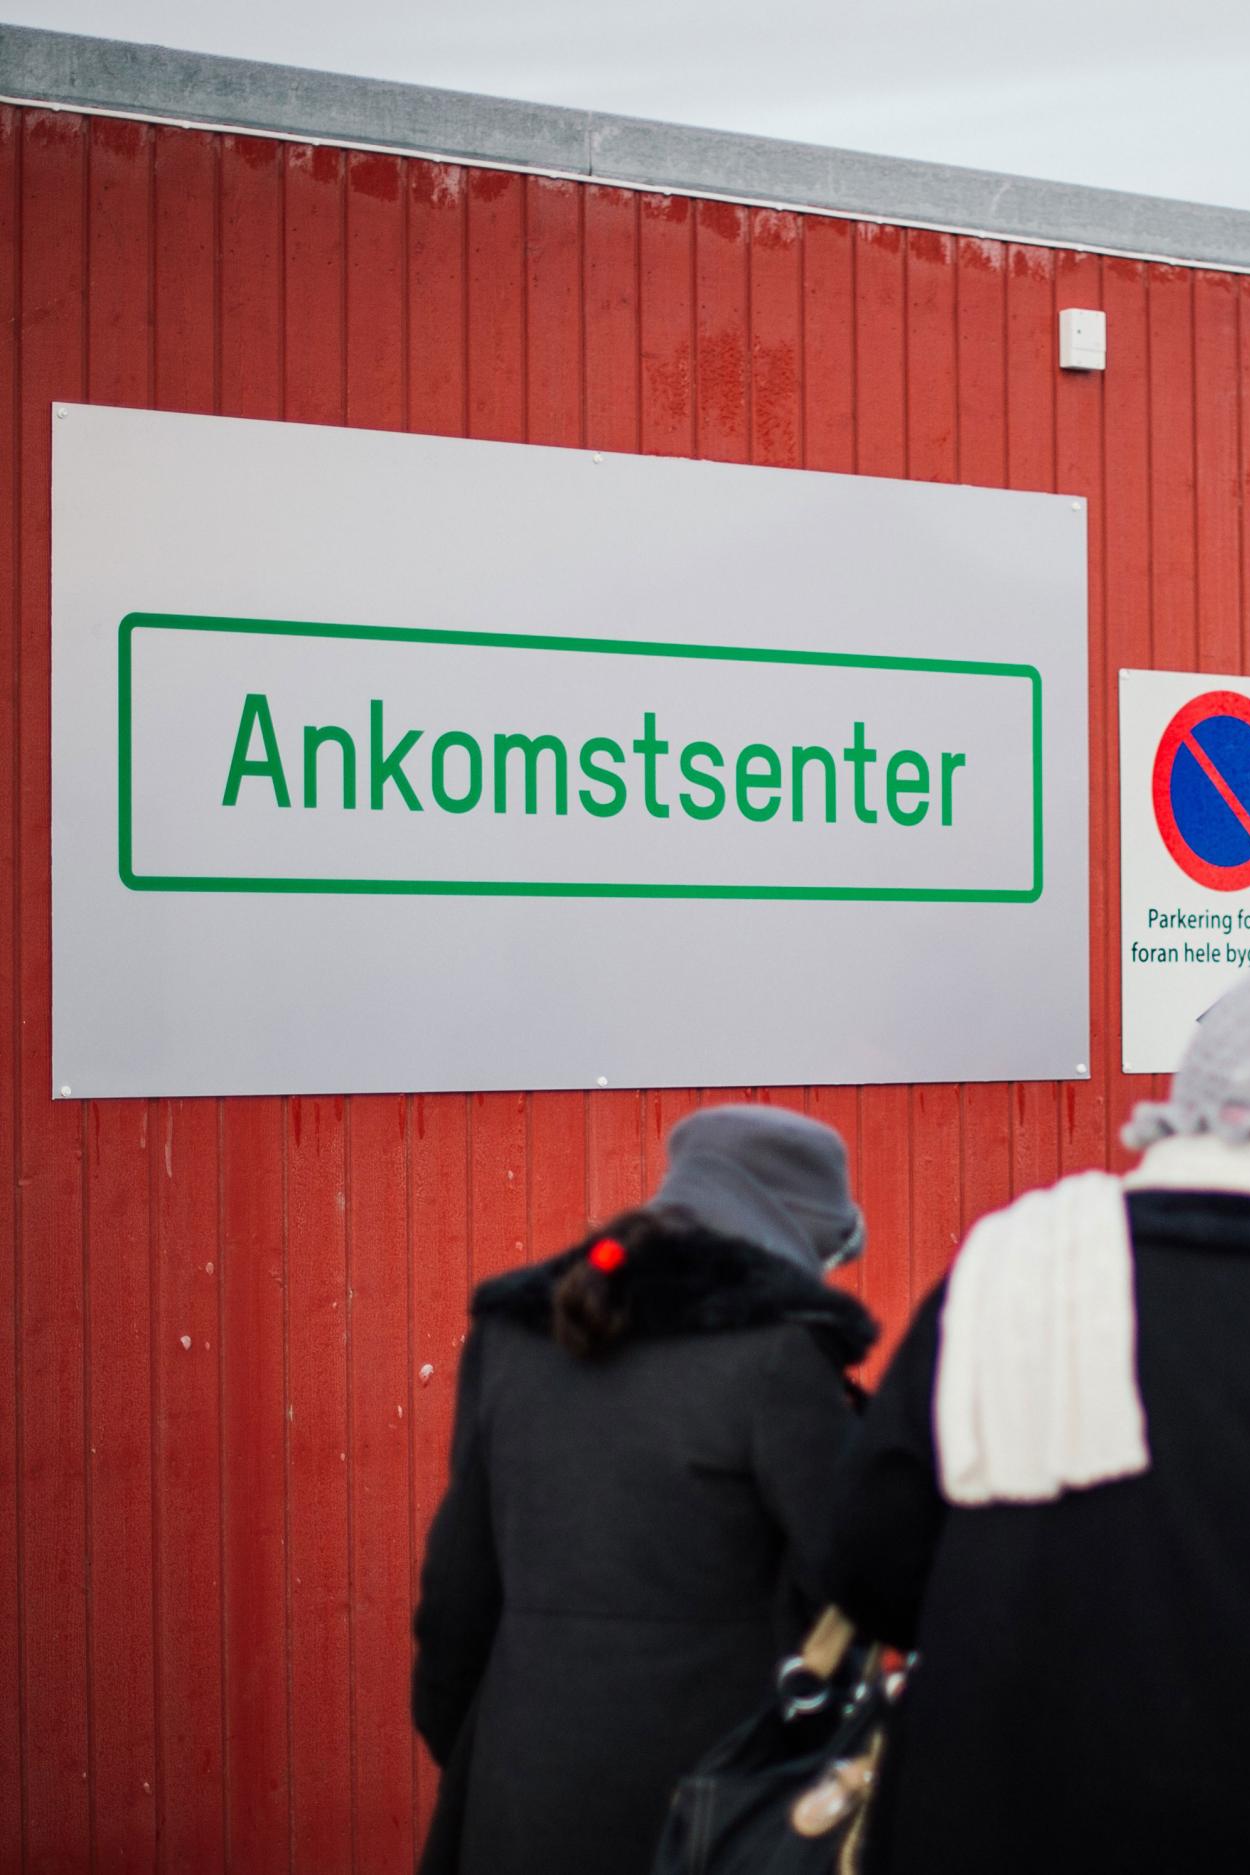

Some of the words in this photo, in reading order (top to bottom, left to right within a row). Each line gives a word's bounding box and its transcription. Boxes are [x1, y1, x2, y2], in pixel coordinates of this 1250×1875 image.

[221, 691, 967, 828] Ankomstsenter
[1147, 908, 1233, 935] Parkering
[1131, 941, 1179, 963] foran
[1184, 942, 1221, 963] hele
